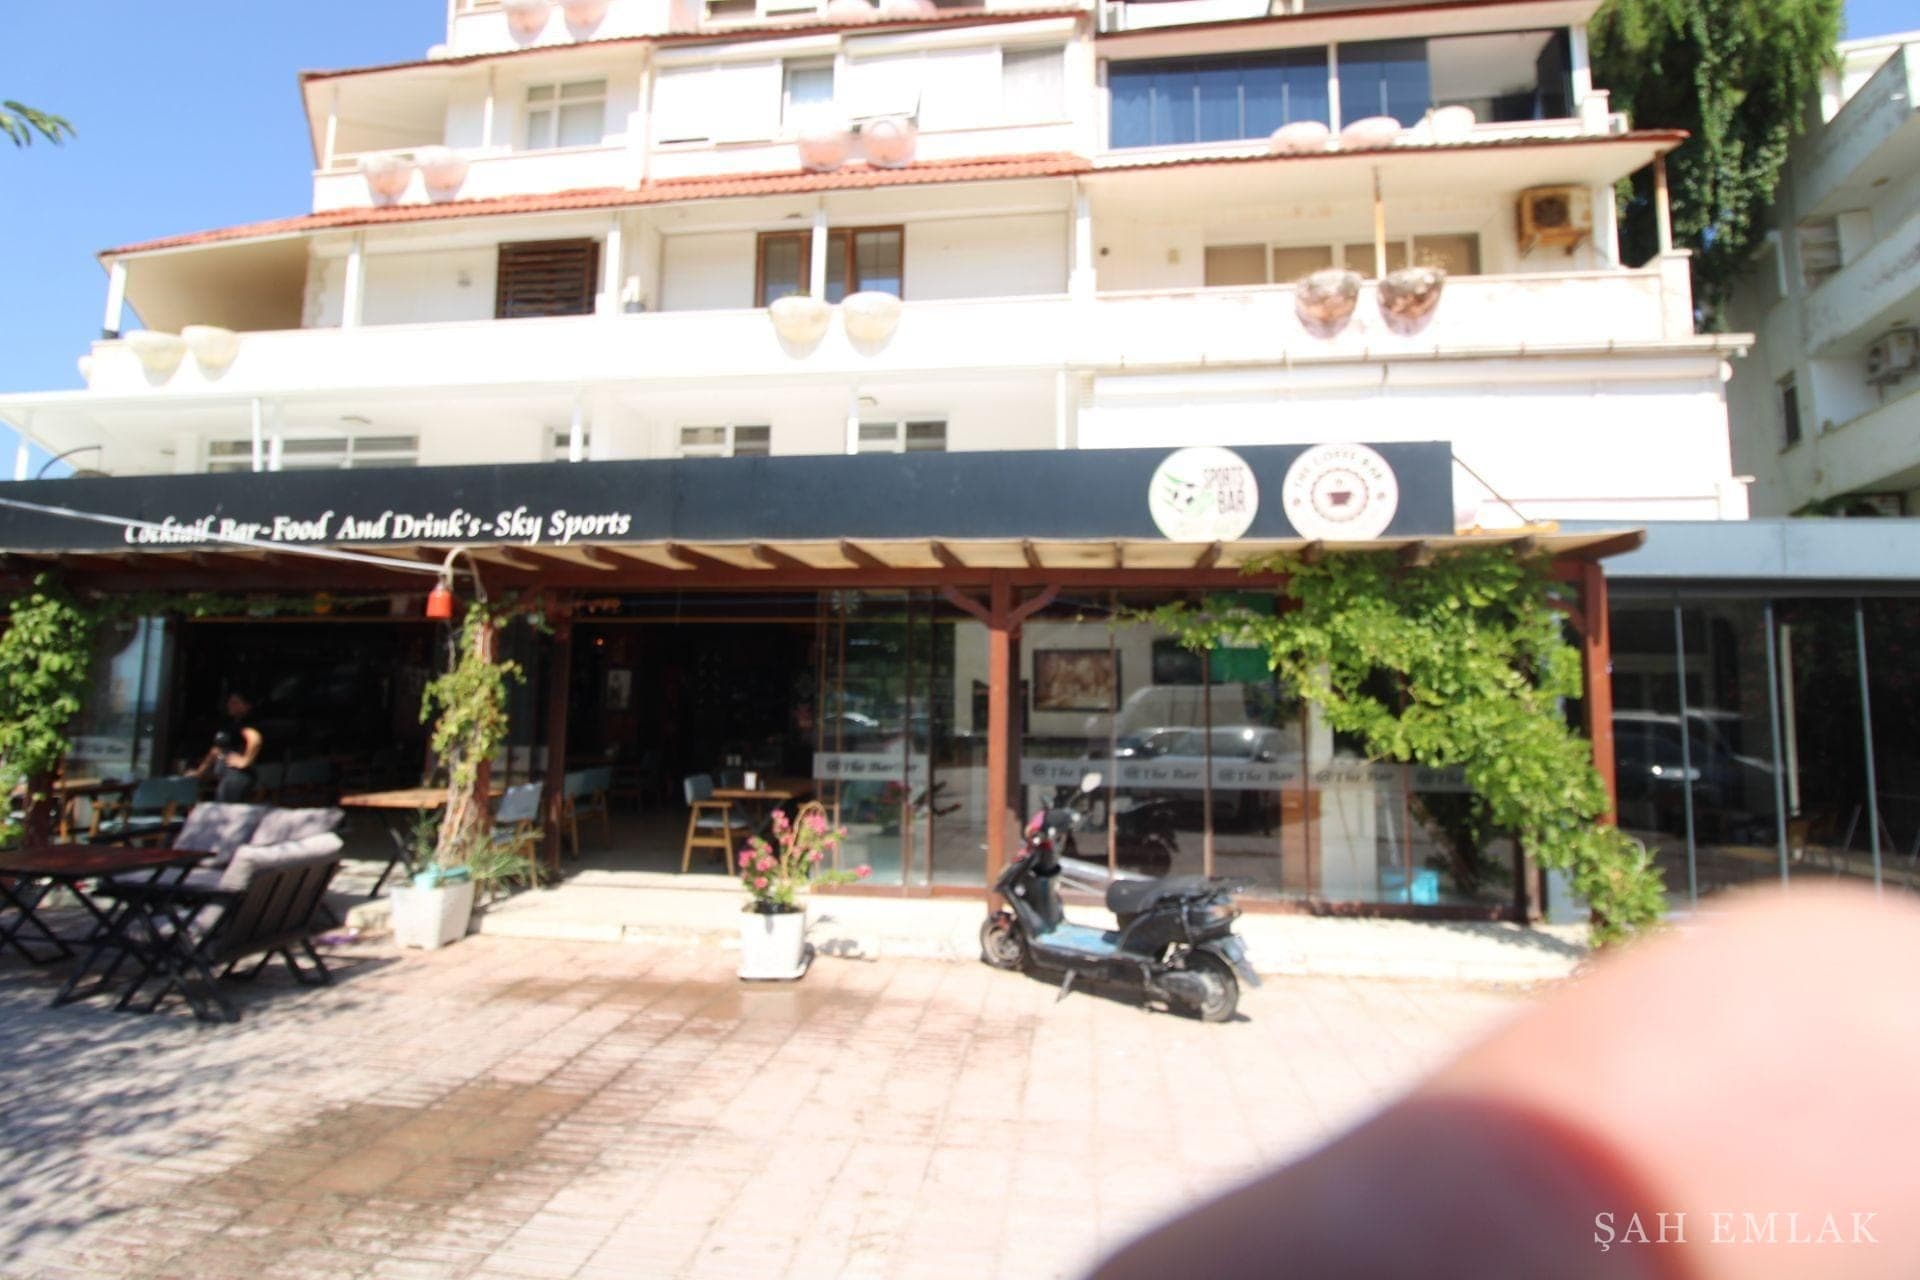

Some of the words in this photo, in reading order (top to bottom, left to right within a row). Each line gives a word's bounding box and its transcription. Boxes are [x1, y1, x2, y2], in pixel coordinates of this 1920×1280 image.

[124, 515, 216, 544] Cocktail
[335, 510, 394, 540] And
[547, 509, 632, 546] Sports
